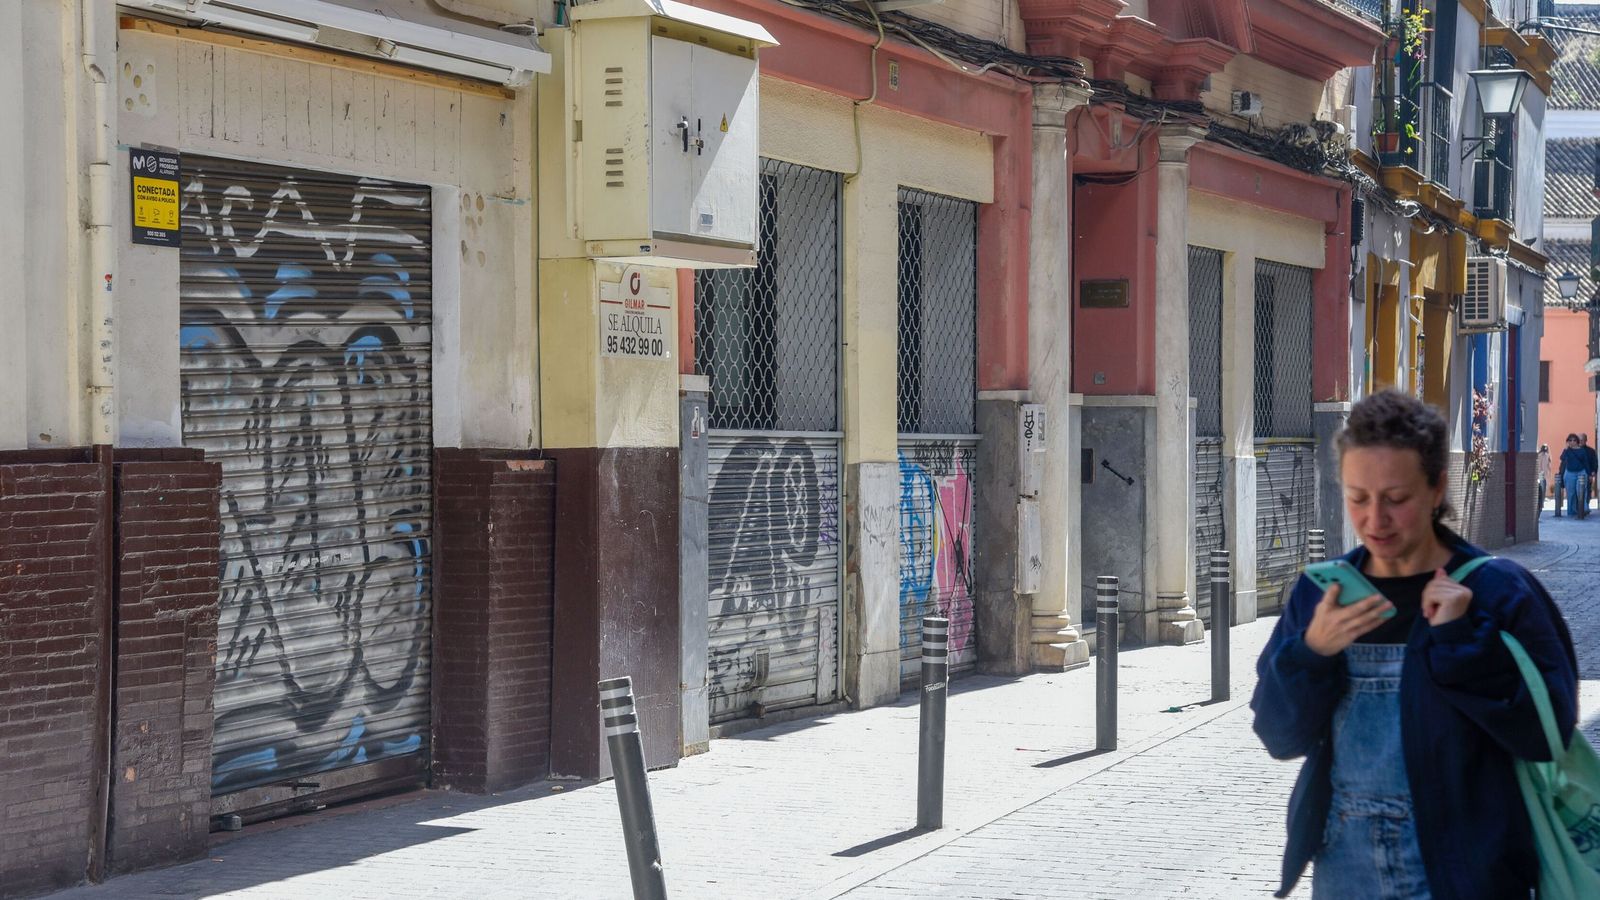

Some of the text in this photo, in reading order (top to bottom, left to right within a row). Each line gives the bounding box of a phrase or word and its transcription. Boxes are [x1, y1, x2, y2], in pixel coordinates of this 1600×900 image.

[137, 185, 176, 197] CONECTADA
[624, 298, 645, 310] GILMAR
[608, 313, 663, 337] SE ALQUILA
[607, 335, 663, 356] 95 432 99 00
